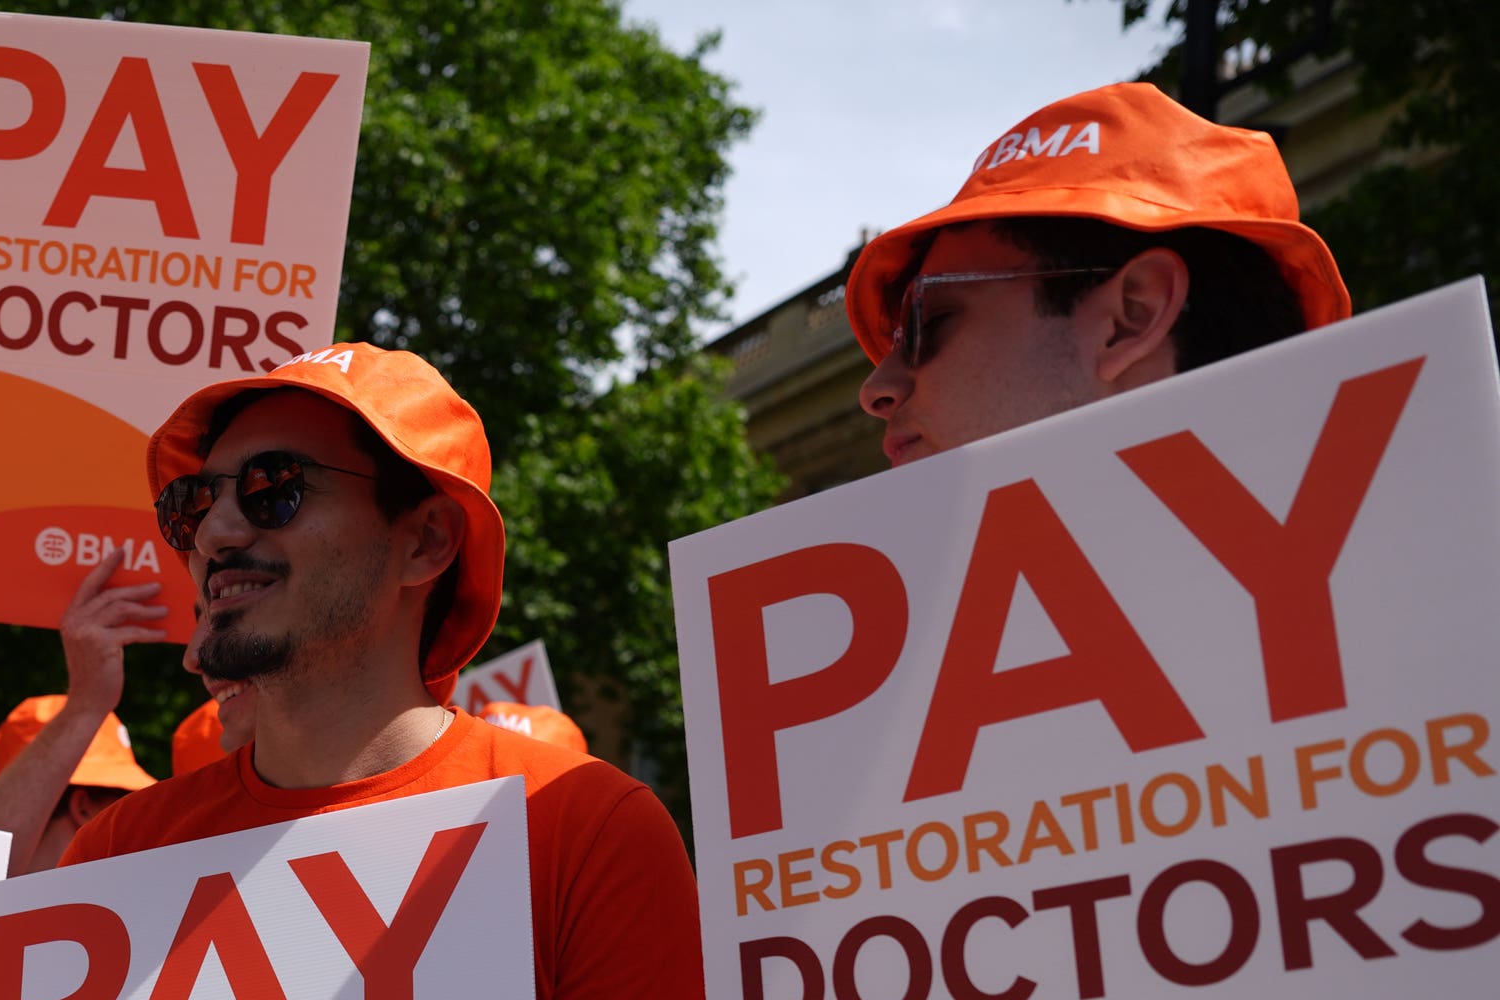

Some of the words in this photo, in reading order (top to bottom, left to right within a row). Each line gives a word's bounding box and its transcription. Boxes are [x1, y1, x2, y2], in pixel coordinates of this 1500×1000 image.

[986, 121, 1100, 170] BMA
[233, 258, 318, 299] FOR
[76, 533, 161, 574] BMA
[708, 356, 1428, 841] PAY
[731, 755, 1271, 918] RESTORATION
[1293, 712, 1497, 811] FOR
